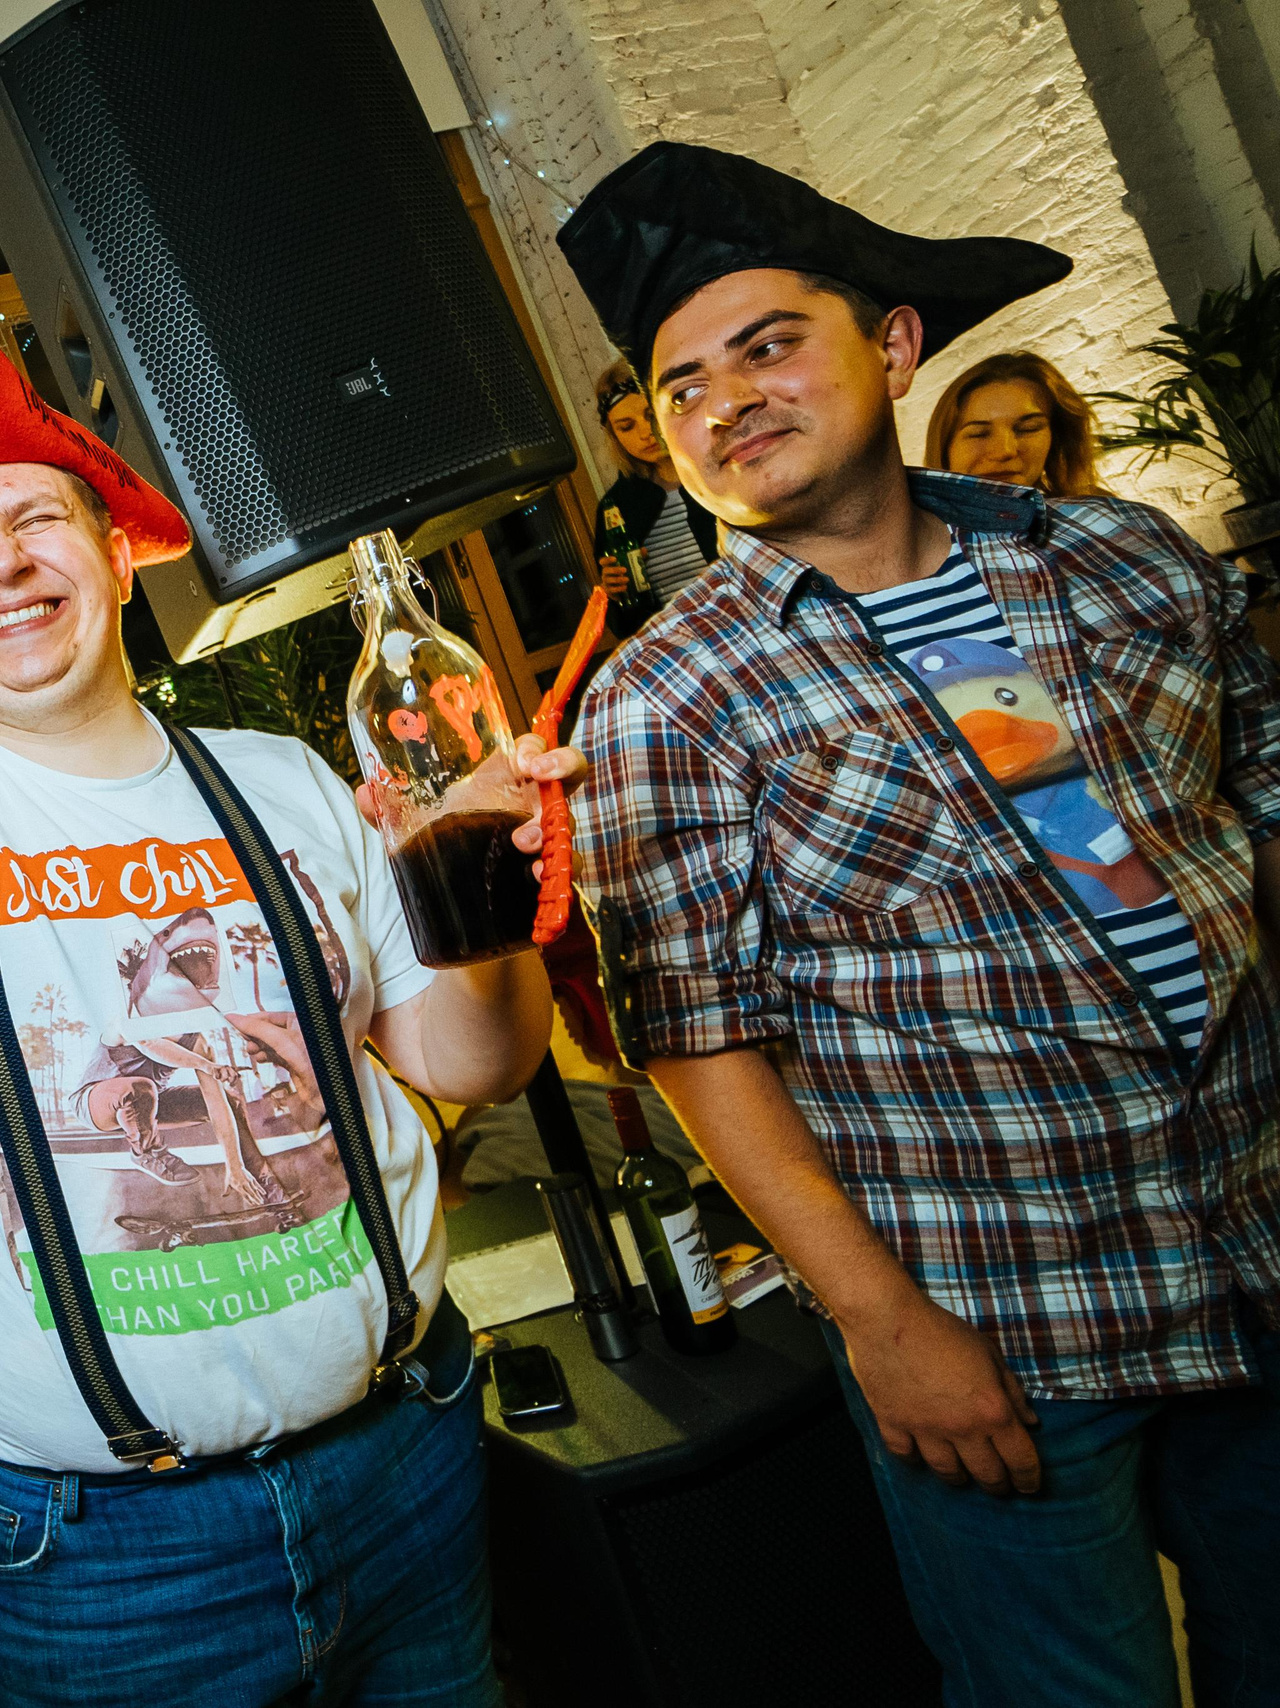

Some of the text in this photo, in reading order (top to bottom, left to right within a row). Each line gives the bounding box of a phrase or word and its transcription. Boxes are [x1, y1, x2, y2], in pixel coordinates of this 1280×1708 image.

[345, 377, 372, 396] JBL
[7, 855, 104, 918] Just
[110, 1260, 220, 1292] CHILL
[96, 1302, 181, 1331] HAN
[197, 1288, 270, 1322] YOU
